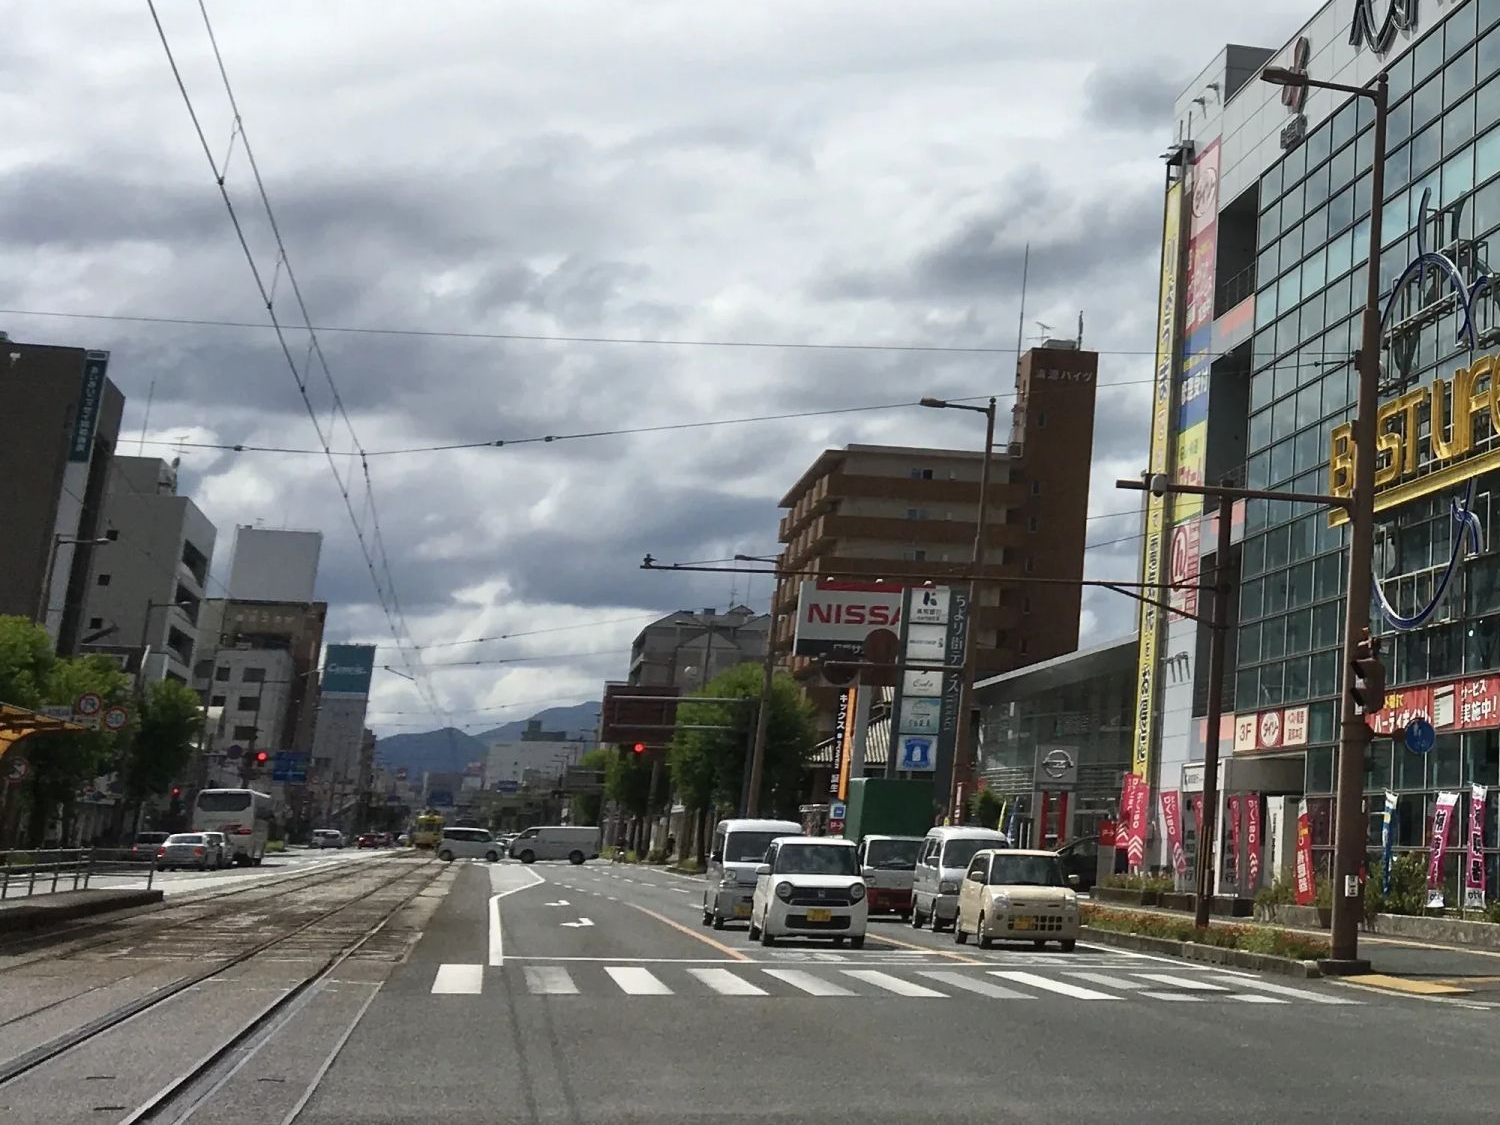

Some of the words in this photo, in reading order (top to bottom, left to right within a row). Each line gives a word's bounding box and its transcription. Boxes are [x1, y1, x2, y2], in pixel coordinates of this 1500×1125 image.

[948, 595, 966, 692] ちより街テス
[1239, 722, 1252, 741] 3F
